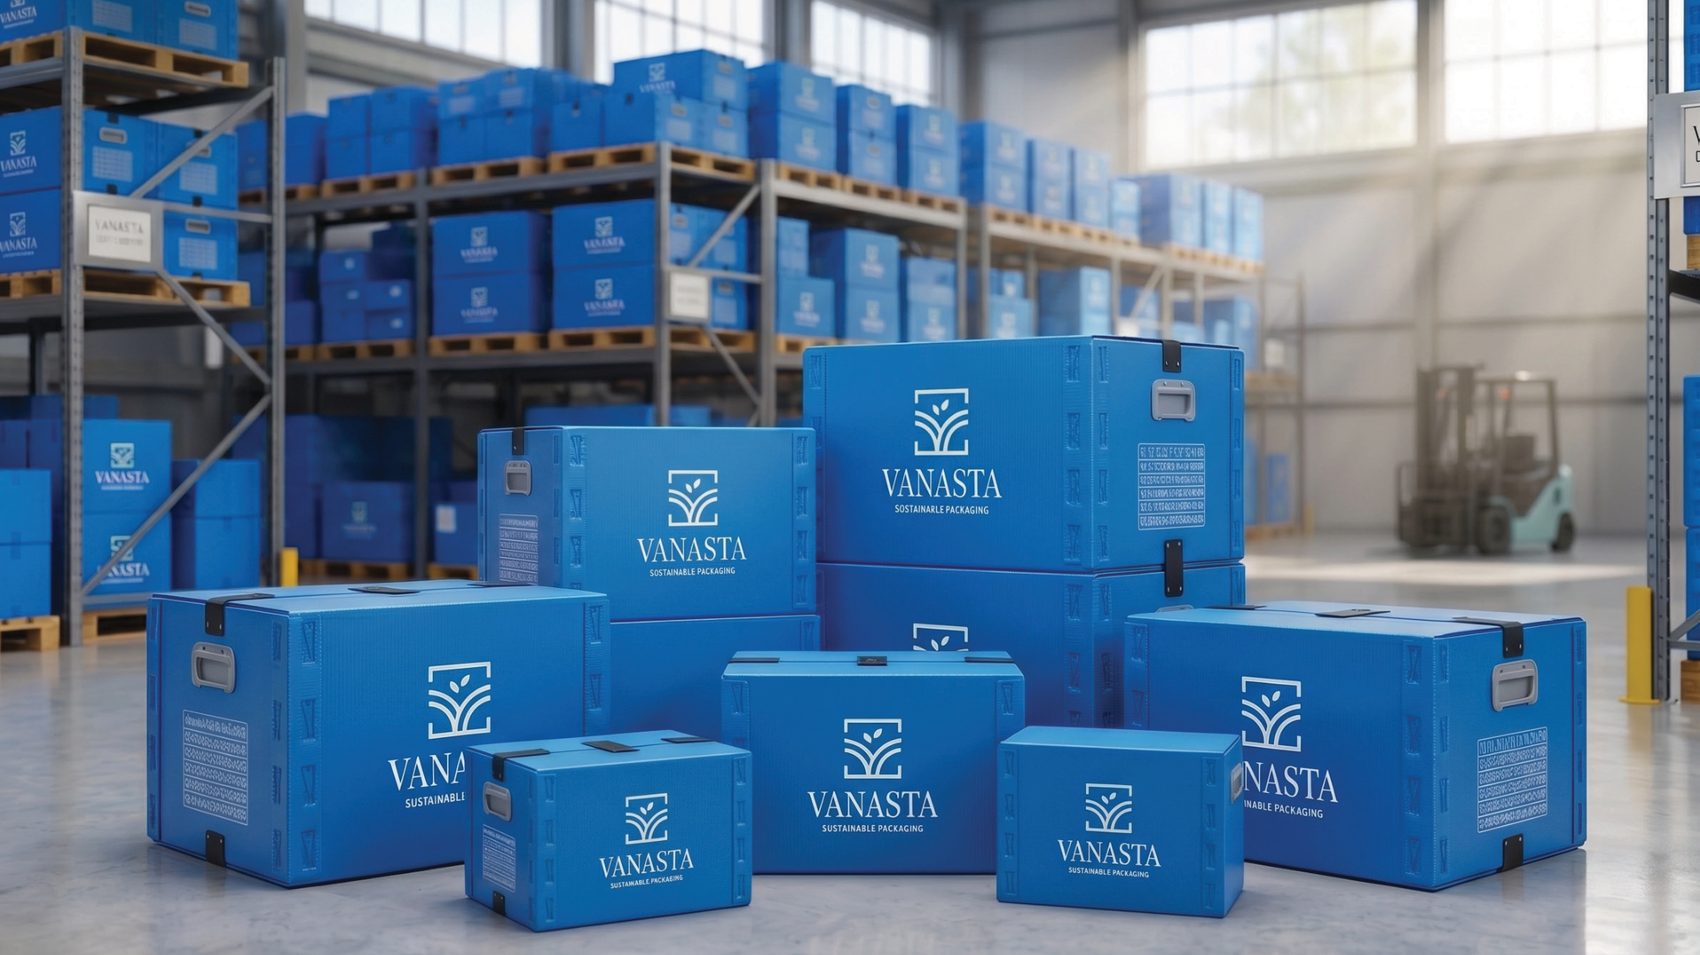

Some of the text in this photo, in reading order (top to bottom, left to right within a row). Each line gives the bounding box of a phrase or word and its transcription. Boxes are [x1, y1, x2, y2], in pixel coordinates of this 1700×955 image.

[95, 470, 150, 484] VANASTA
[881, 468, 1002, 498] VANASTA
[945, 505, 989, 515] PACKAGING
[637, 536, 747, 563] VANASTA
[697, 566, 736, 576] PACKAGING
[807, 790, 939, 818] VANASTA
[1274, 803, 1323, 819] PACKAGING
[822, 824, 924, 833] SUSTAINABLE PACKAGING
[1057, 839, 1162, 867] VANASTA
[599, 848, 694, 879] VANASTA
[1068, 866, 1150, 879] SUSTAINABLE PACKAGING
